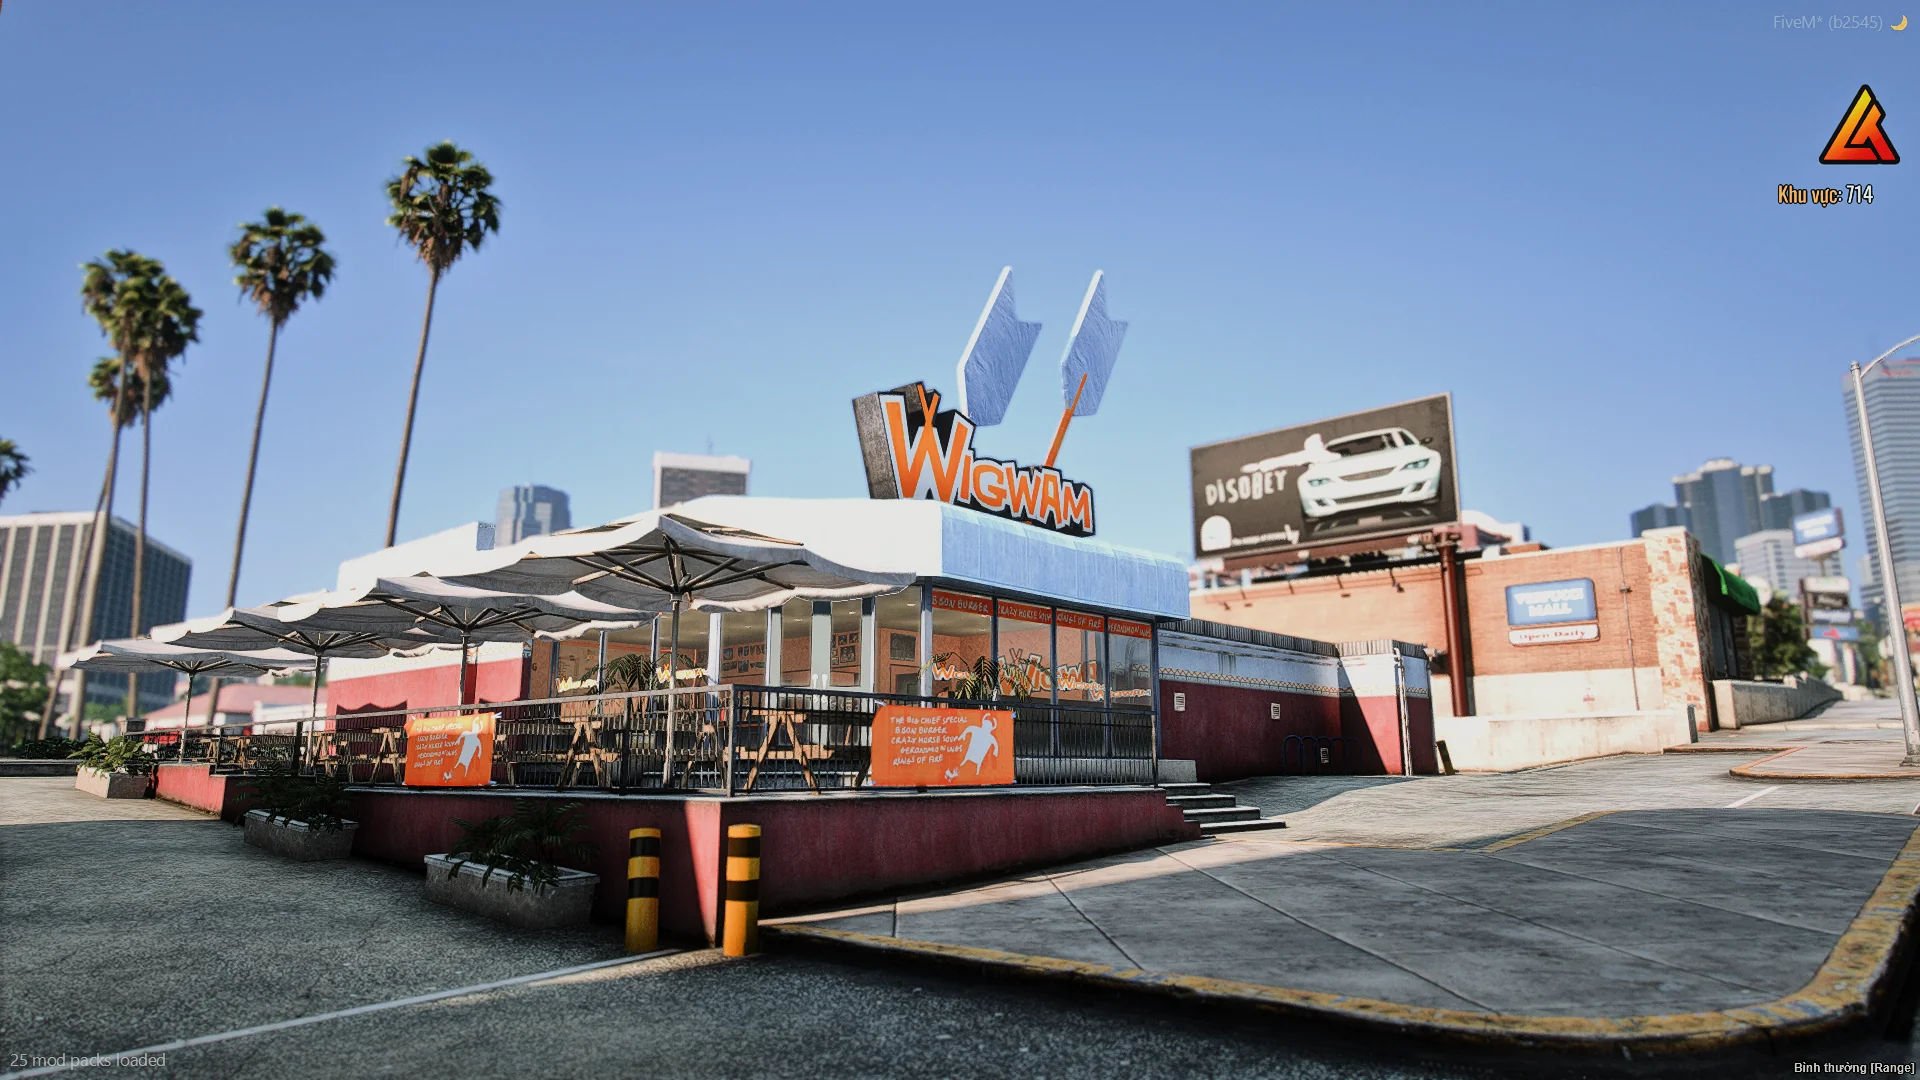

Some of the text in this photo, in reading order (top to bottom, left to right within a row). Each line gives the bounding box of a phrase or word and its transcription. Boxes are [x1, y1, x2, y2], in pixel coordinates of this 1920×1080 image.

[878, 384, 1094, 533] WIGWAM
[918, 726, 947, 735] BURGER
[916, 756, 927, 764] OF
